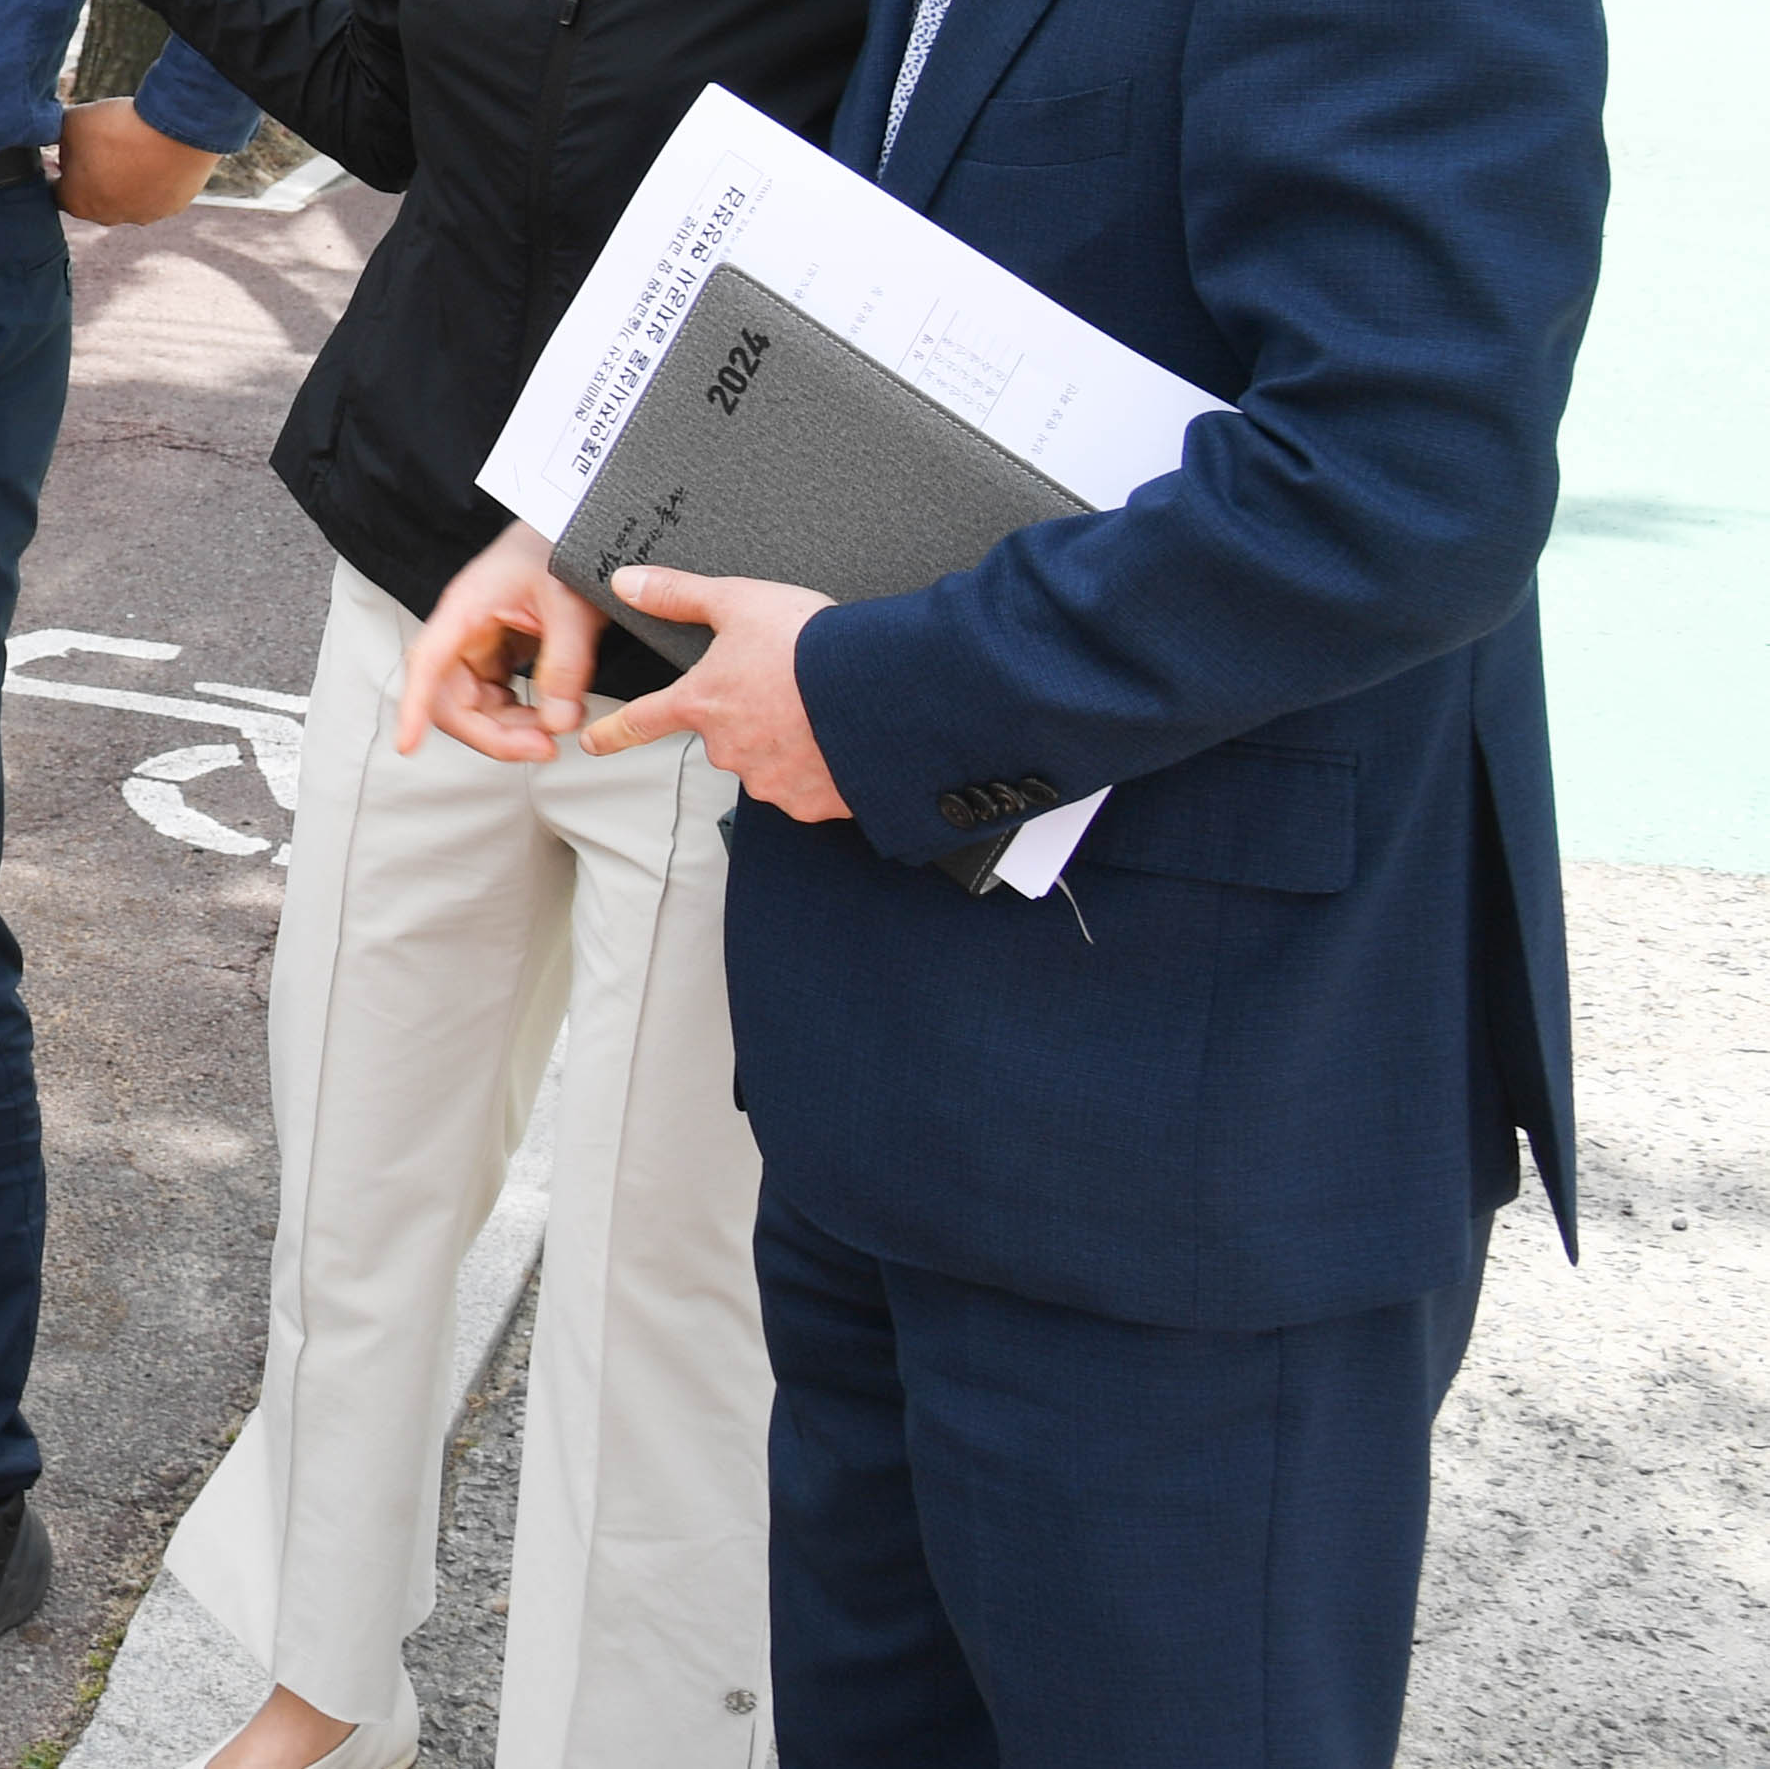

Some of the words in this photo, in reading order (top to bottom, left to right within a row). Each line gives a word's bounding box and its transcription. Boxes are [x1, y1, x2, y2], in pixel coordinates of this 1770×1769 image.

[572, 349, 651, 477] 교통안전시설물
[646, 267, 697, 344] 설치공사
[691, 186, 746, 263] 현장점검
[575, 346, 624, 422] 현대미포조선
[621, 278, 662, 342] 기술교육원
[669, 216, 698, 256] 교차로
[707, 328, 771, 416] 2024
